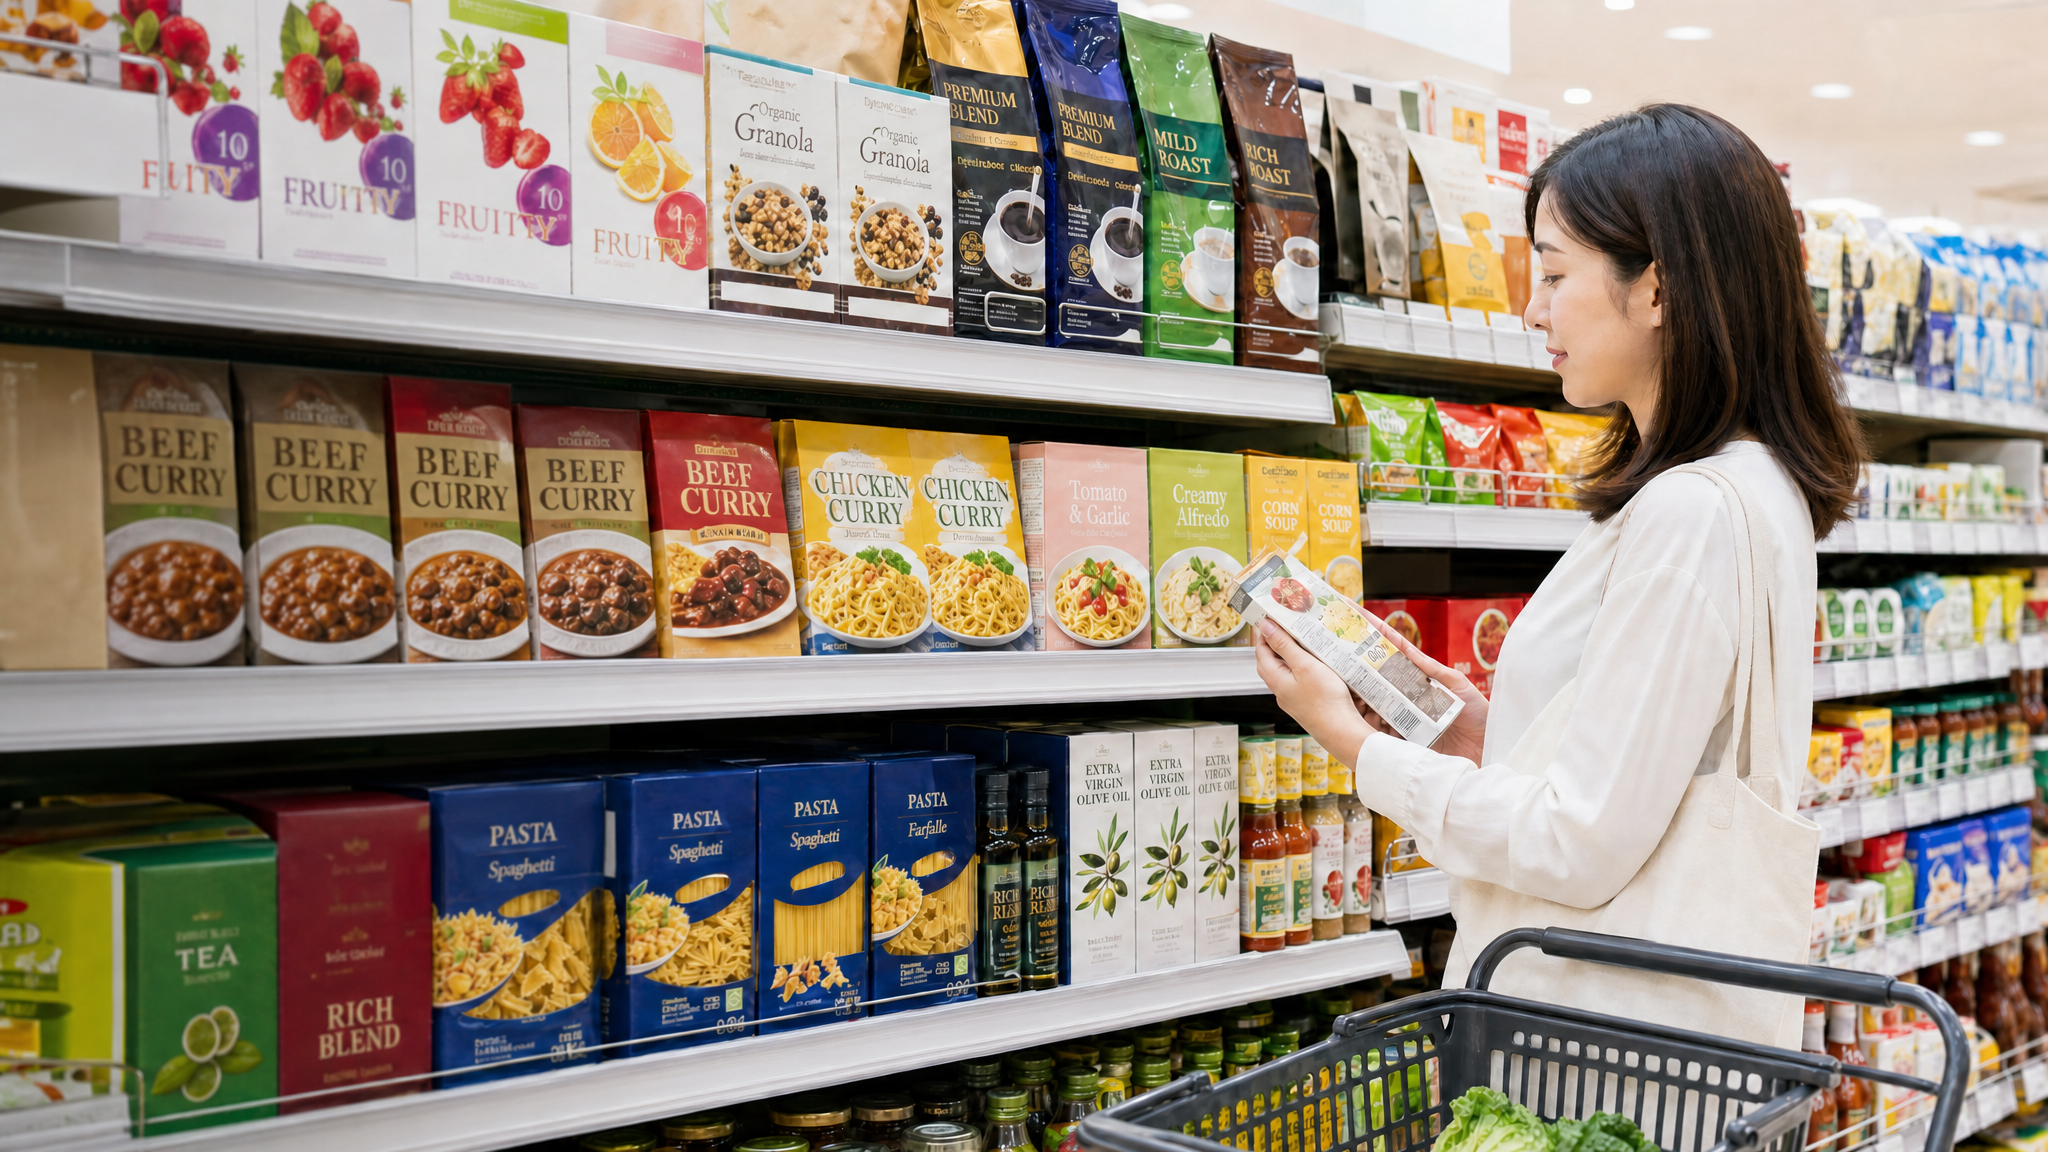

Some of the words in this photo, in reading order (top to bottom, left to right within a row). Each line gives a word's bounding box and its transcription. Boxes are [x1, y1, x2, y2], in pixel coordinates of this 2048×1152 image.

[943, 82, 1017, 108] PREMIUM
[758, 101, 801, 122] Organic
[950, 103, 999, 125] BLEND
[1058, 102, 1116, 130] PREMIUM
[735, 112, 814, 153] Granola
[880, 126, 918, 147] Organic
[1062, 120, 1102, 144] BLEND
[1154, 128, 1197, 152] MILD
[217, 129, 248, 161] 10
[1245, 142, 1279, 165] RICH
[381, 155, 407, 184] 10
[1158, 149, 1211, 175] ROAST
[1249, 162, 1291, 186] ROAST
[538, 184, 563, 211] 10
[593, 228, 694, 266] FRUITY
[120, 425, 220, 461] BEEF
[272, 437, 368, 471] BEEF
[415, 446, 499, 479] BEEF
[546, 459, 626, 484] BEEF
[684, 459, 752, 487] BEEF
[115, 462, 227, 497] CURRY
[266, 472, 377, 505] CURRY
[814, 470, 910, 499] CHICKEN
[924, 476, 1010, 502] CHICKEN
[1069, 480, 1127, 502] Tomato
[409, 480, 509, 511] CURRY
[539, 486, 635, 512] CURRY
[681, 487, 772, 517] CURRY
[1173, 484, 1228, 511] Creamy
[829, 498, 903, 525] CURRY
[938, 503, 1004, 528] CURRY
[1069, 504, 1082, 524] &
[1087, 505, 1130, 526] Garlic
[1176, 506, 1229, 528] Alfredo
[1262, 500, 1299, 516] CORN
[1318, 504, 1352, 518] CORN
[1265, 516, 1298, 531] SOUP
[1322, 519, 1352, 533] SOUP
[1085, 763, 1121, 776] EXTRA
[1149, 758, 1183, 771] EXTRA
[1205, 754, 1231, 767] EXTRA
[1084, 777, 1123, 791] VIRGIN
[1149, 772, 1185, 785] VIRGIN
[1204, 767, 1232, 781] VIRGIN
[1076, 792, 1110, 806] OLIVE
[1113, 790, 1131, 803] OIL
[1140, 787, 1172, 800] OLIVE
[1174, 786, 1191, 797] OIL
[1198, 781, 1223, 795] OLIVE
[1224, 780, 1238, 792] OIL
[794, 799, 839, 818] PASTA
[908, 792, 948, 809] PASTA
[672, 810, 722, 831] PASTA
[908, 820, 948, 839] Farfalle
[489, 821, 558, 847] PASTA
[790, 829, 840, 850] Spaghetti
[669, 841, 723, 863] Spaghetti
[488, 856, 556, 882] Spaghetti
[175, 944, 239, 971] TEA
[327, 996, 394, 1031] RICH
[318, 1023, 401, 1060] BLEND
